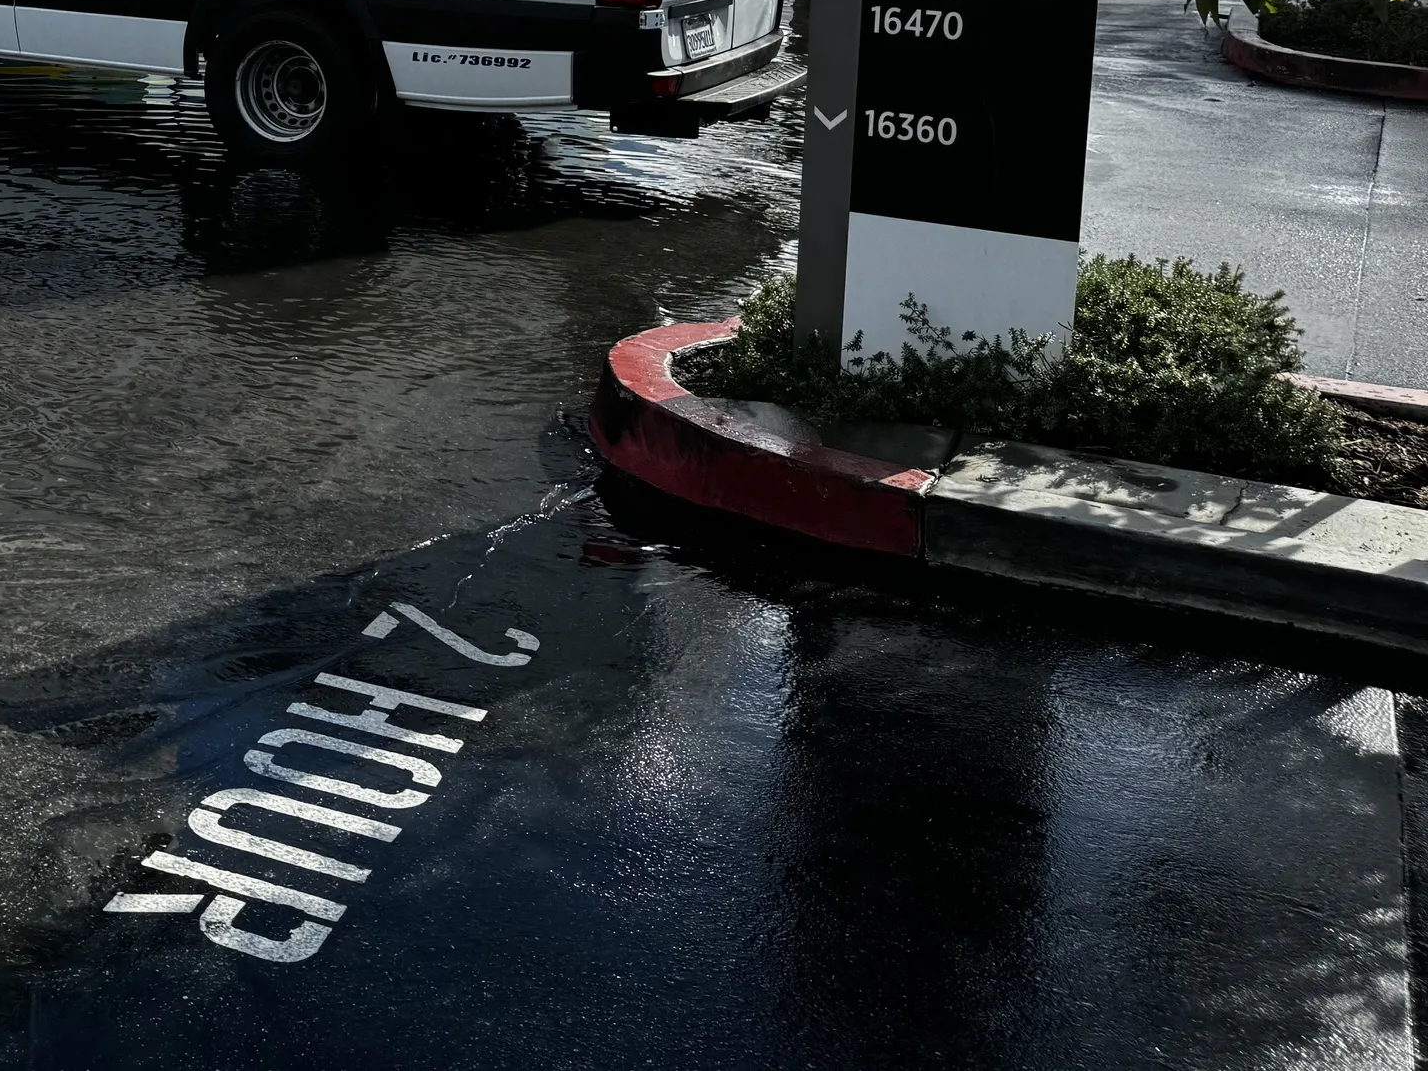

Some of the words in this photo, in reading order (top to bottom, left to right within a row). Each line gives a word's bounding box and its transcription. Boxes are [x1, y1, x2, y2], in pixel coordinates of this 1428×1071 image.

[870, 6, 964, 40] 16470
[865, 109, 958, 145] 16360
[362, 601, 540, 667] 2
[103, 672, 488, 963] HOUR
